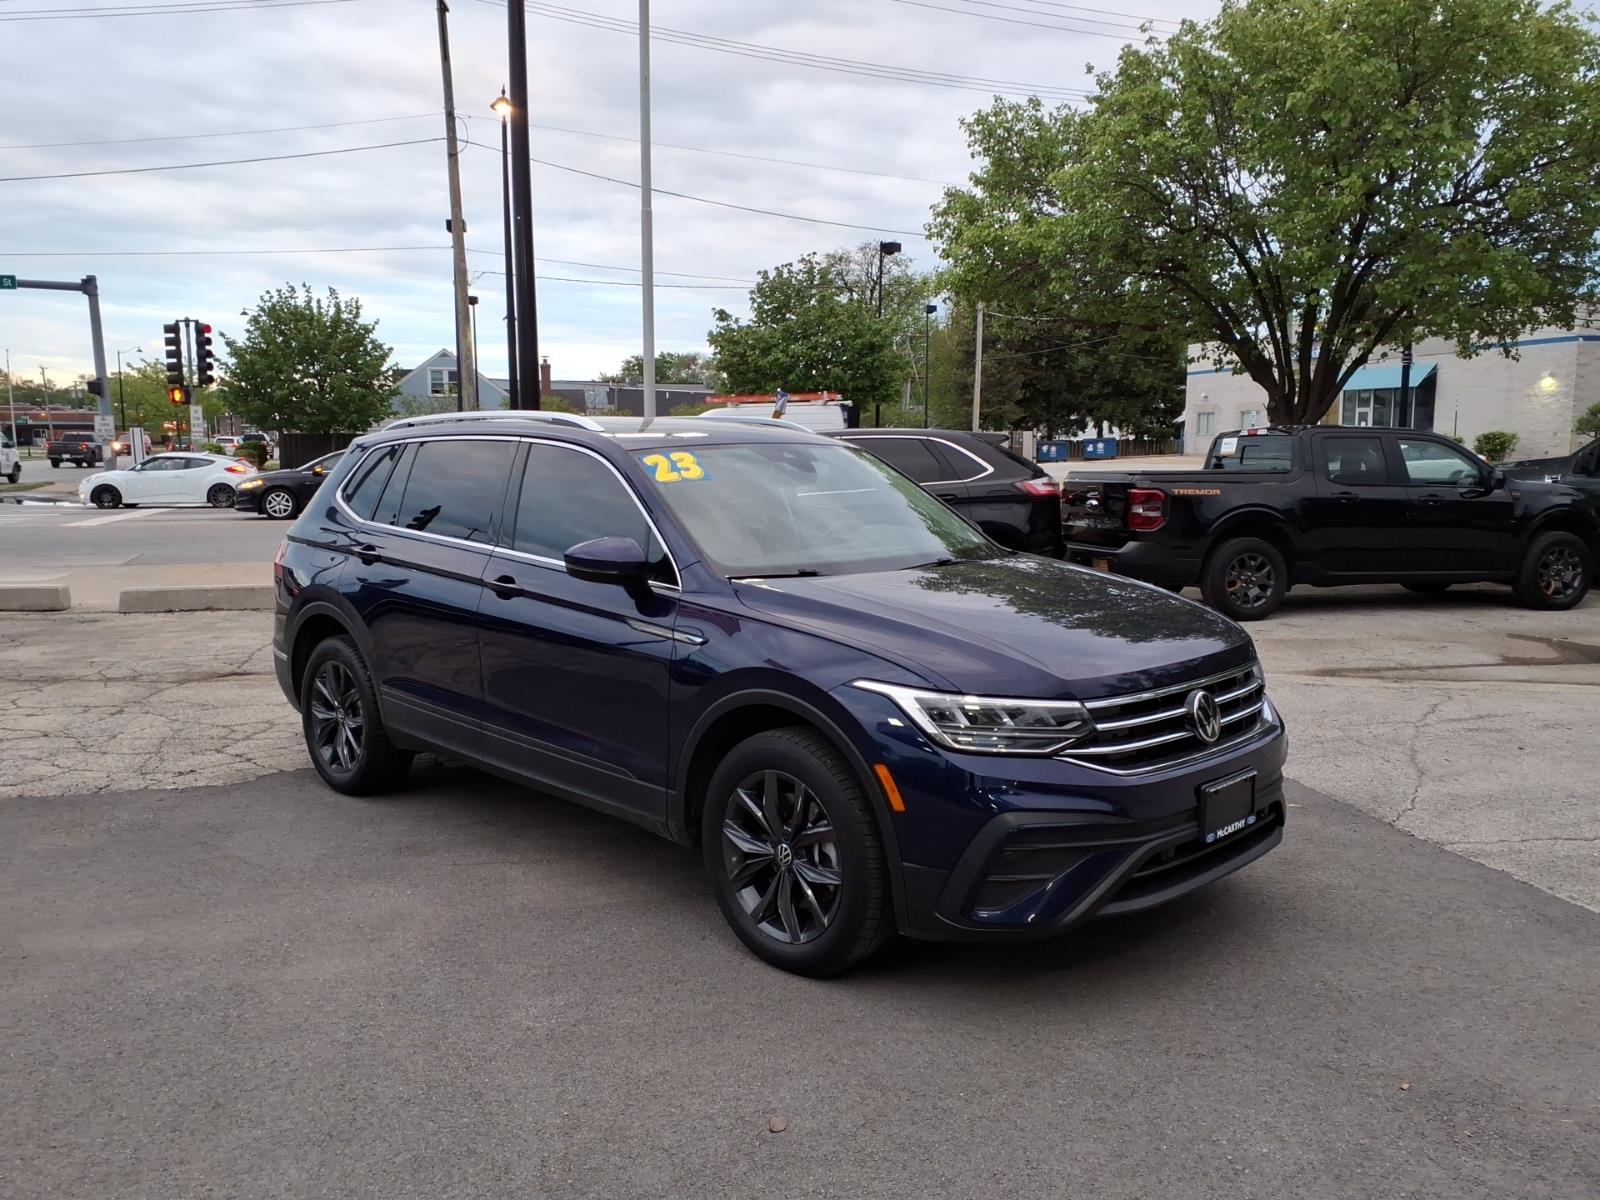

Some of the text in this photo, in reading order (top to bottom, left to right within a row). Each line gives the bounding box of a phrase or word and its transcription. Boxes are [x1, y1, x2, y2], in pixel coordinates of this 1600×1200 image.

[3, 278, 12, 287] St
[643, 452, 705, 483] 23
[1171, 488, 1221, 496] TREMOR
